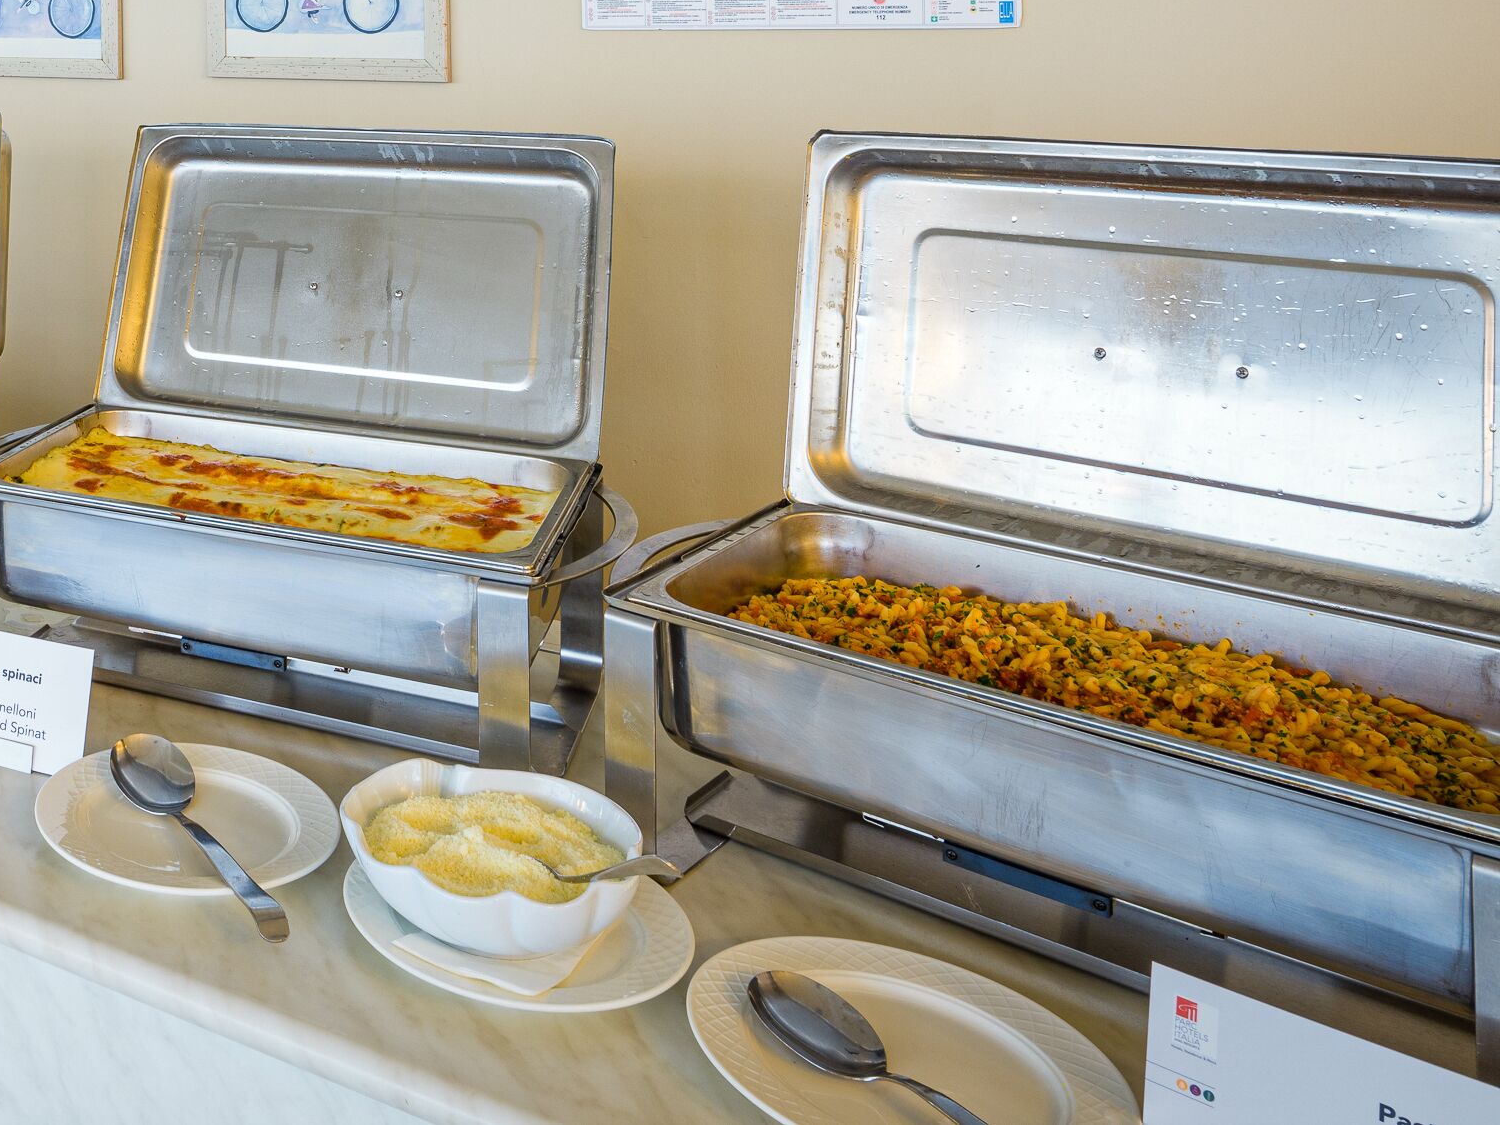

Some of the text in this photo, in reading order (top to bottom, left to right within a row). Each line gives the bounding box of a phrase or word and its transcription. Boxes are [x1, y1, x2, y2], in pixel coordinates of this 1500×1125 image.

[2, 668, 43, 685] spinaci
[10, 721, 47, 741] Spinat
[1174, 1016, 1198, 1031] PARC
[1174, 1024, 1209, 1043] HOTELS
[1174, 1031, 1201, 1047] ITALIA
